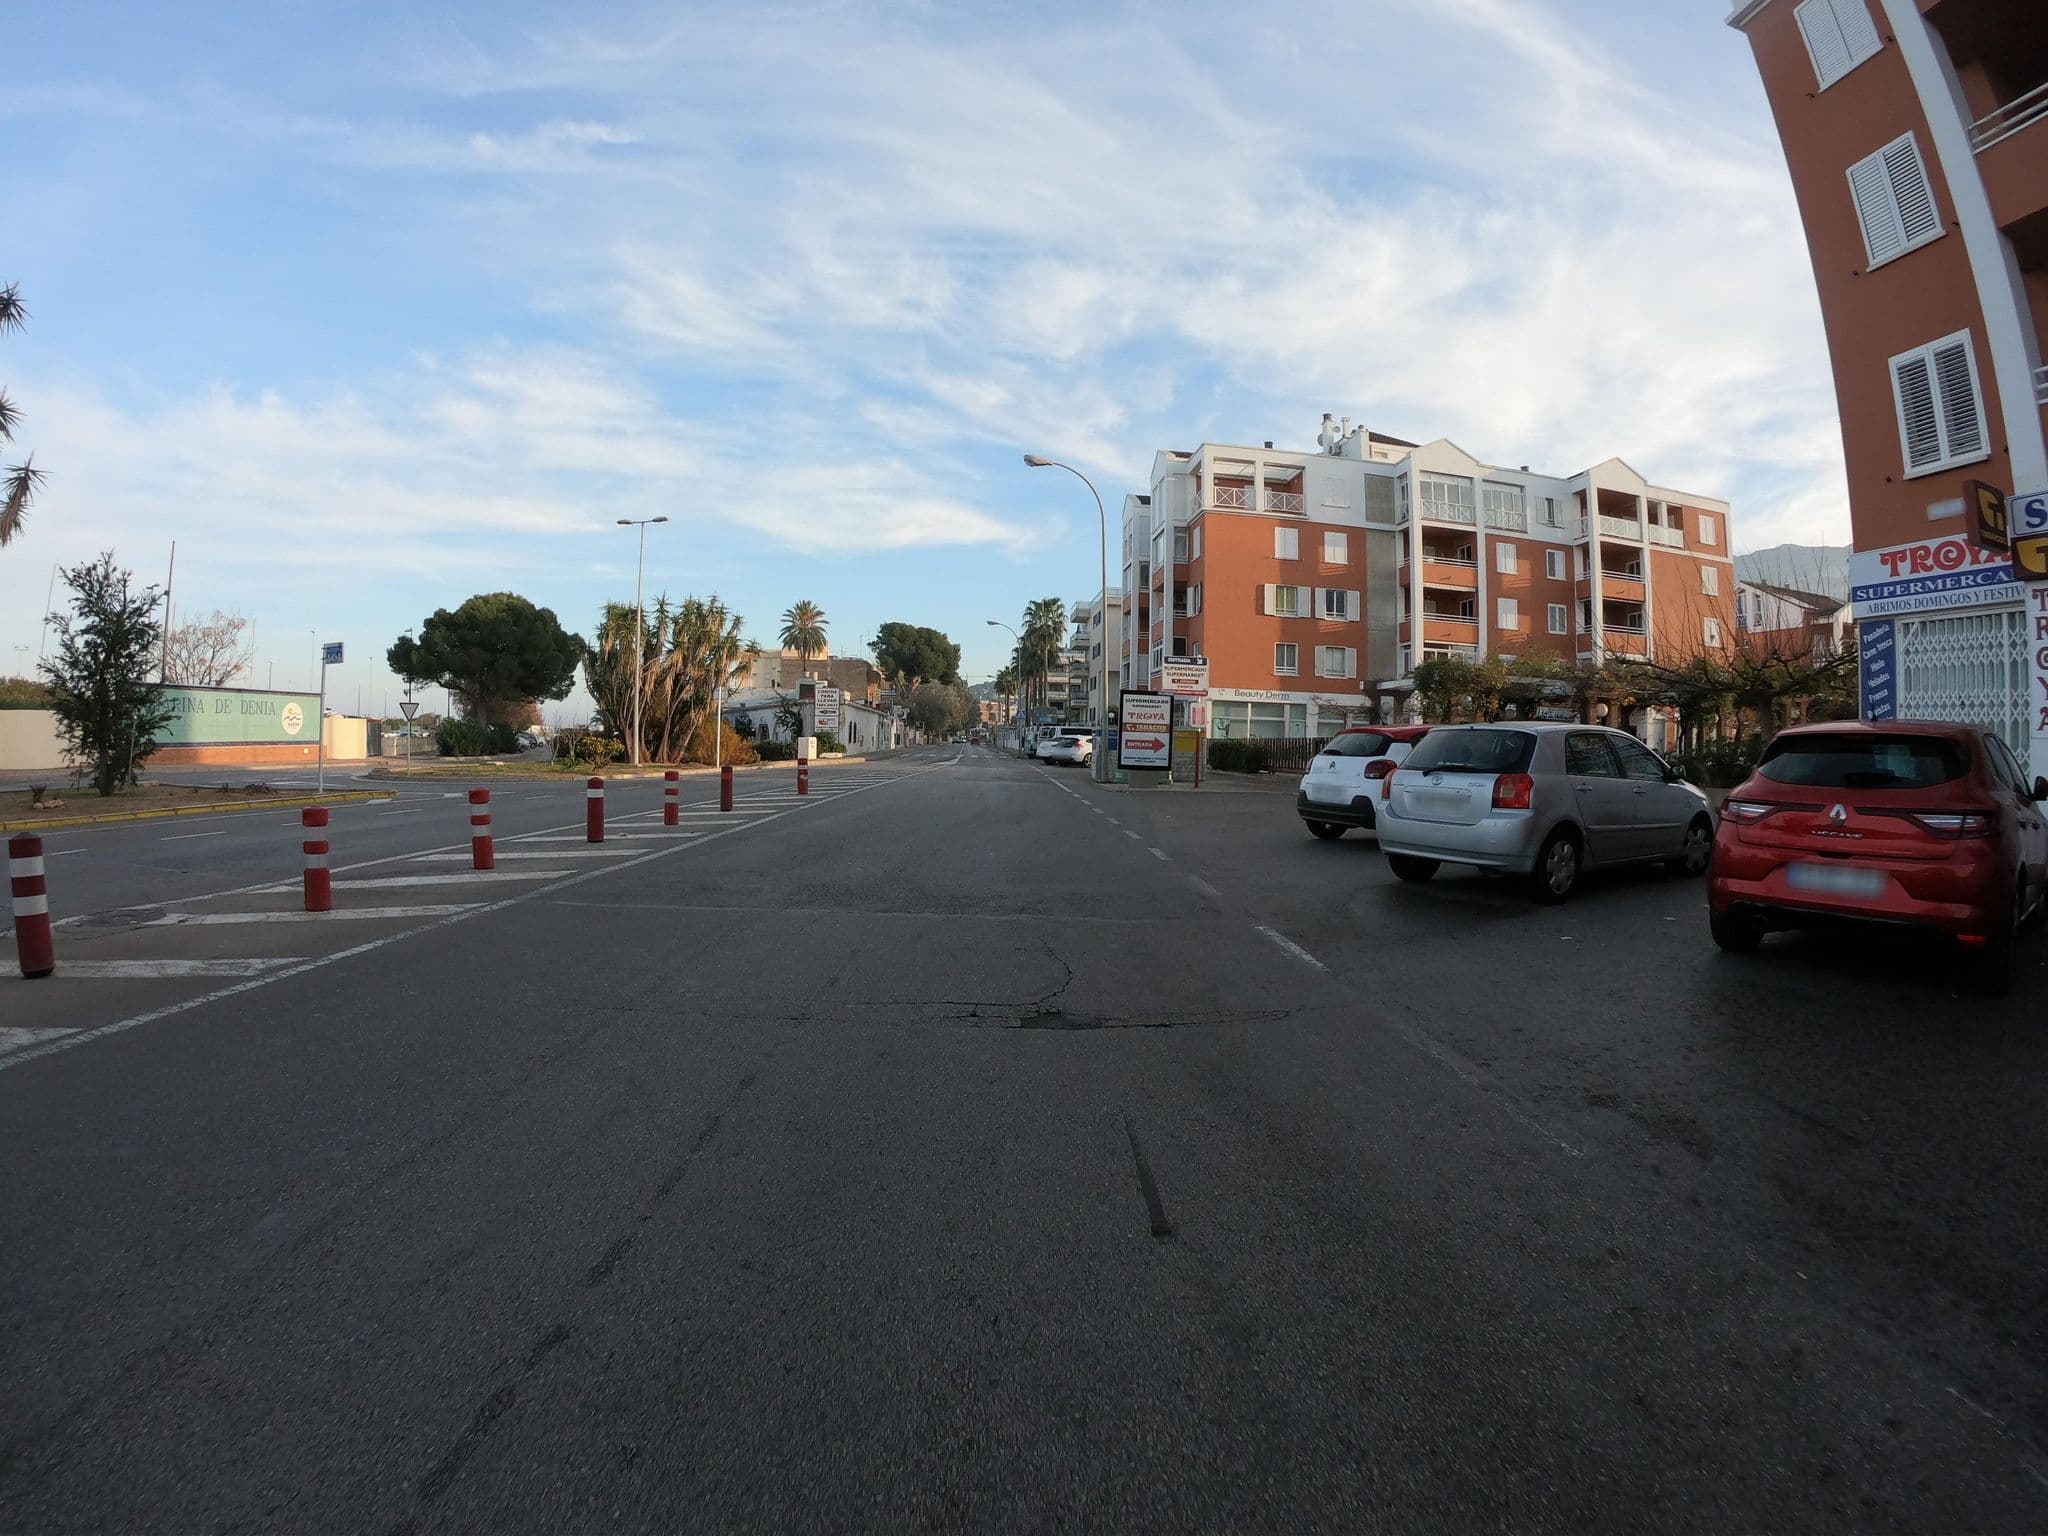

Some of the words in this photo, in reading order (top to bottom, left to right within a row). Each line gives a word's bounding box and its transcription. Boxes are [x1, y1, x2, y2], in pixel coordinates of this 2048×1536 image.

[1856, 569, 2014, 600] SUPERMERCA
[1867, 599, 1912, 614] ABRIMOS
[1914, 591, 1971, 609] DOMINGOS
[1971, 590, 1981, 603] Y
[1984, 585, 2025, 602] FESTIV
[1234, 689, 1264, 698] Beauty
[1266, 691, 1290, 699] Derm
[215, 698, 232, 714] DE
[240, 699, 276, 716] DENIA
[1127, 711, 1166, 721] TROYA
